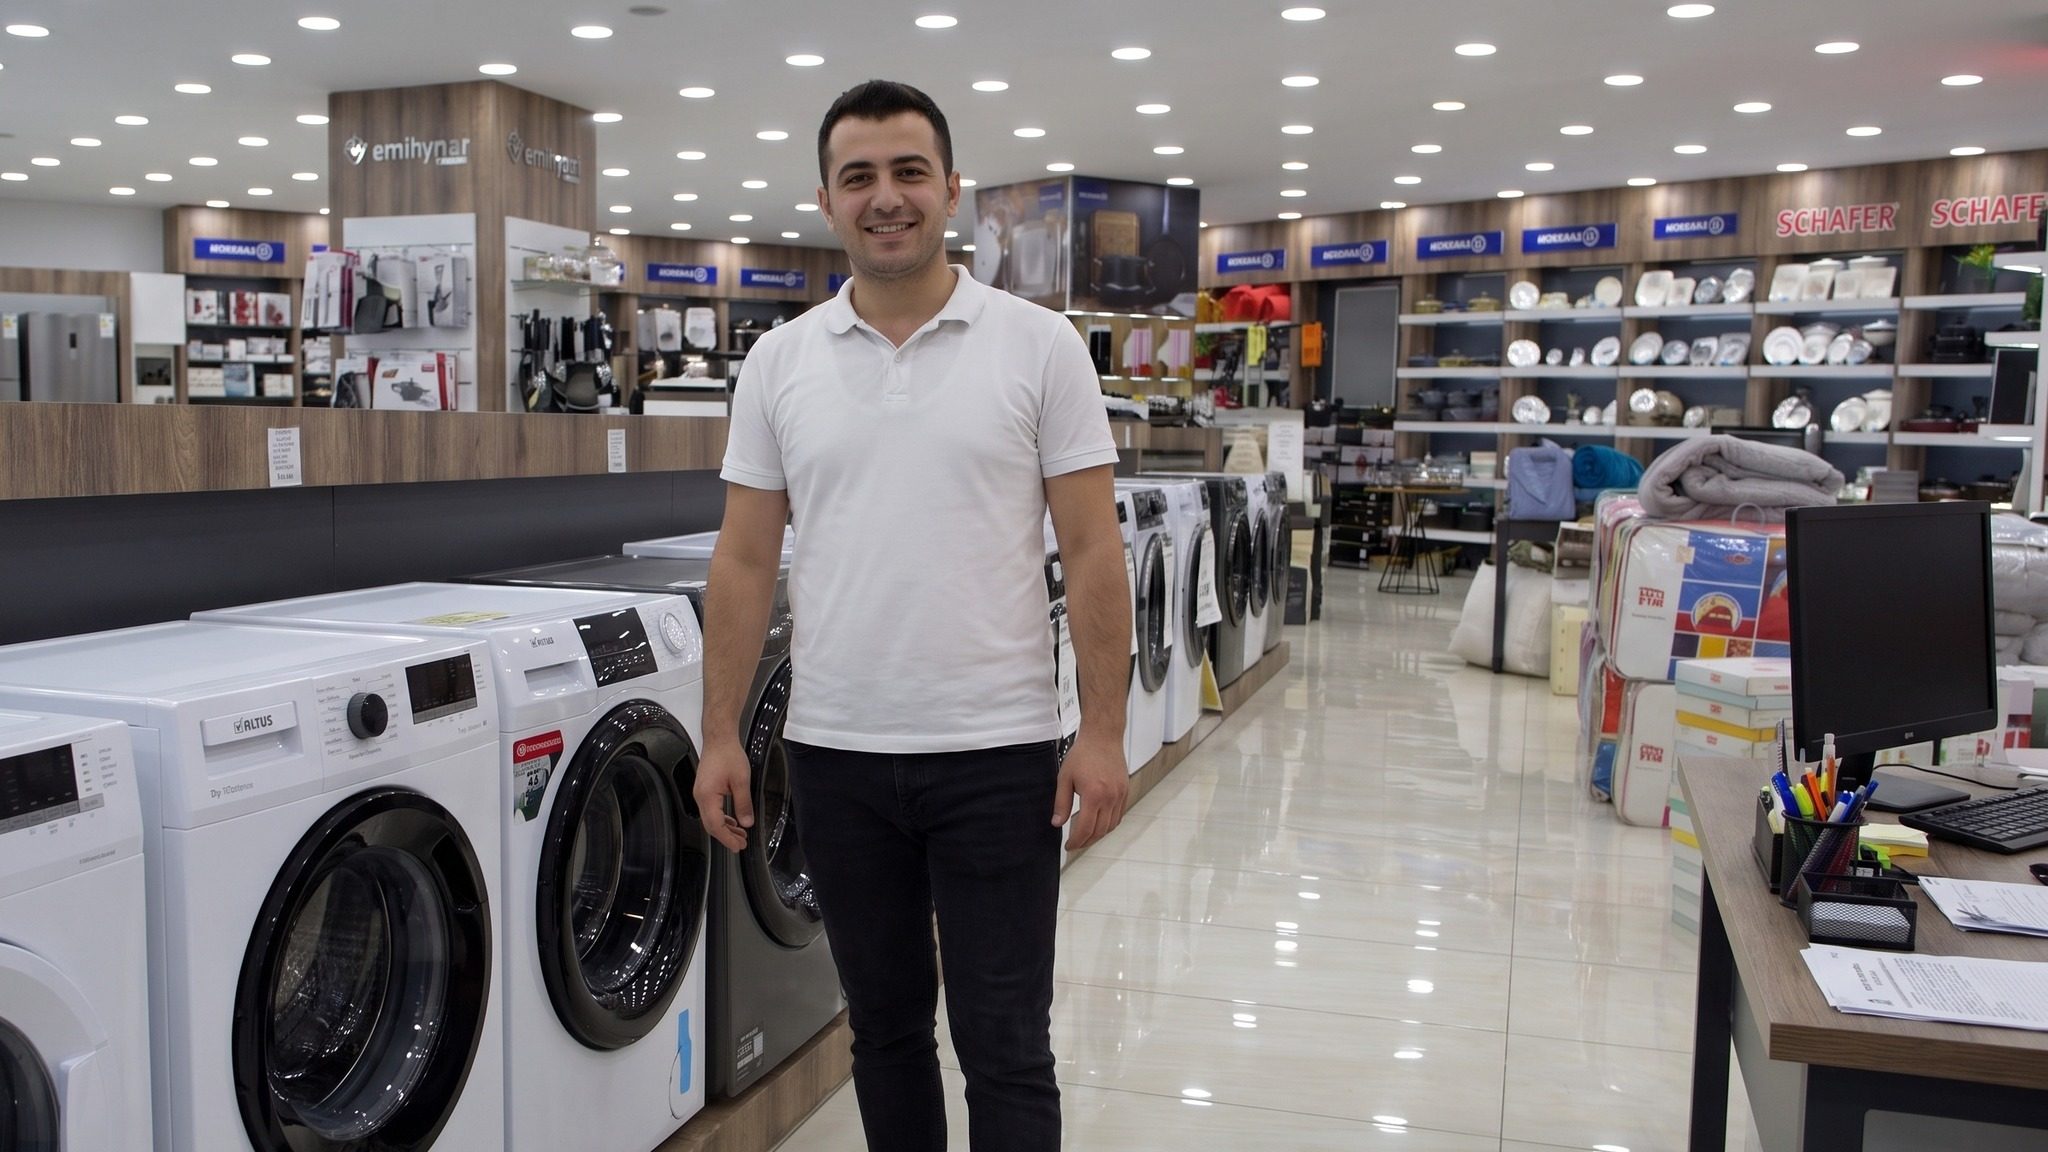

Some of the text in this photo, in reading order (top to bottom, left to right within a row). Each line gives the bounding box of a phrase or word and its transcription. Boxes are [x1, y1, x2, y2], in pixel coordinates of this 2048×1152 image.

[372, 136, 470, 164] emihynar
[1776, 203, 1896, 237] SCHAFER
[1930, 192, 2047, 228] SCHAFE
[243, 714, 273, 732] ALTUS
